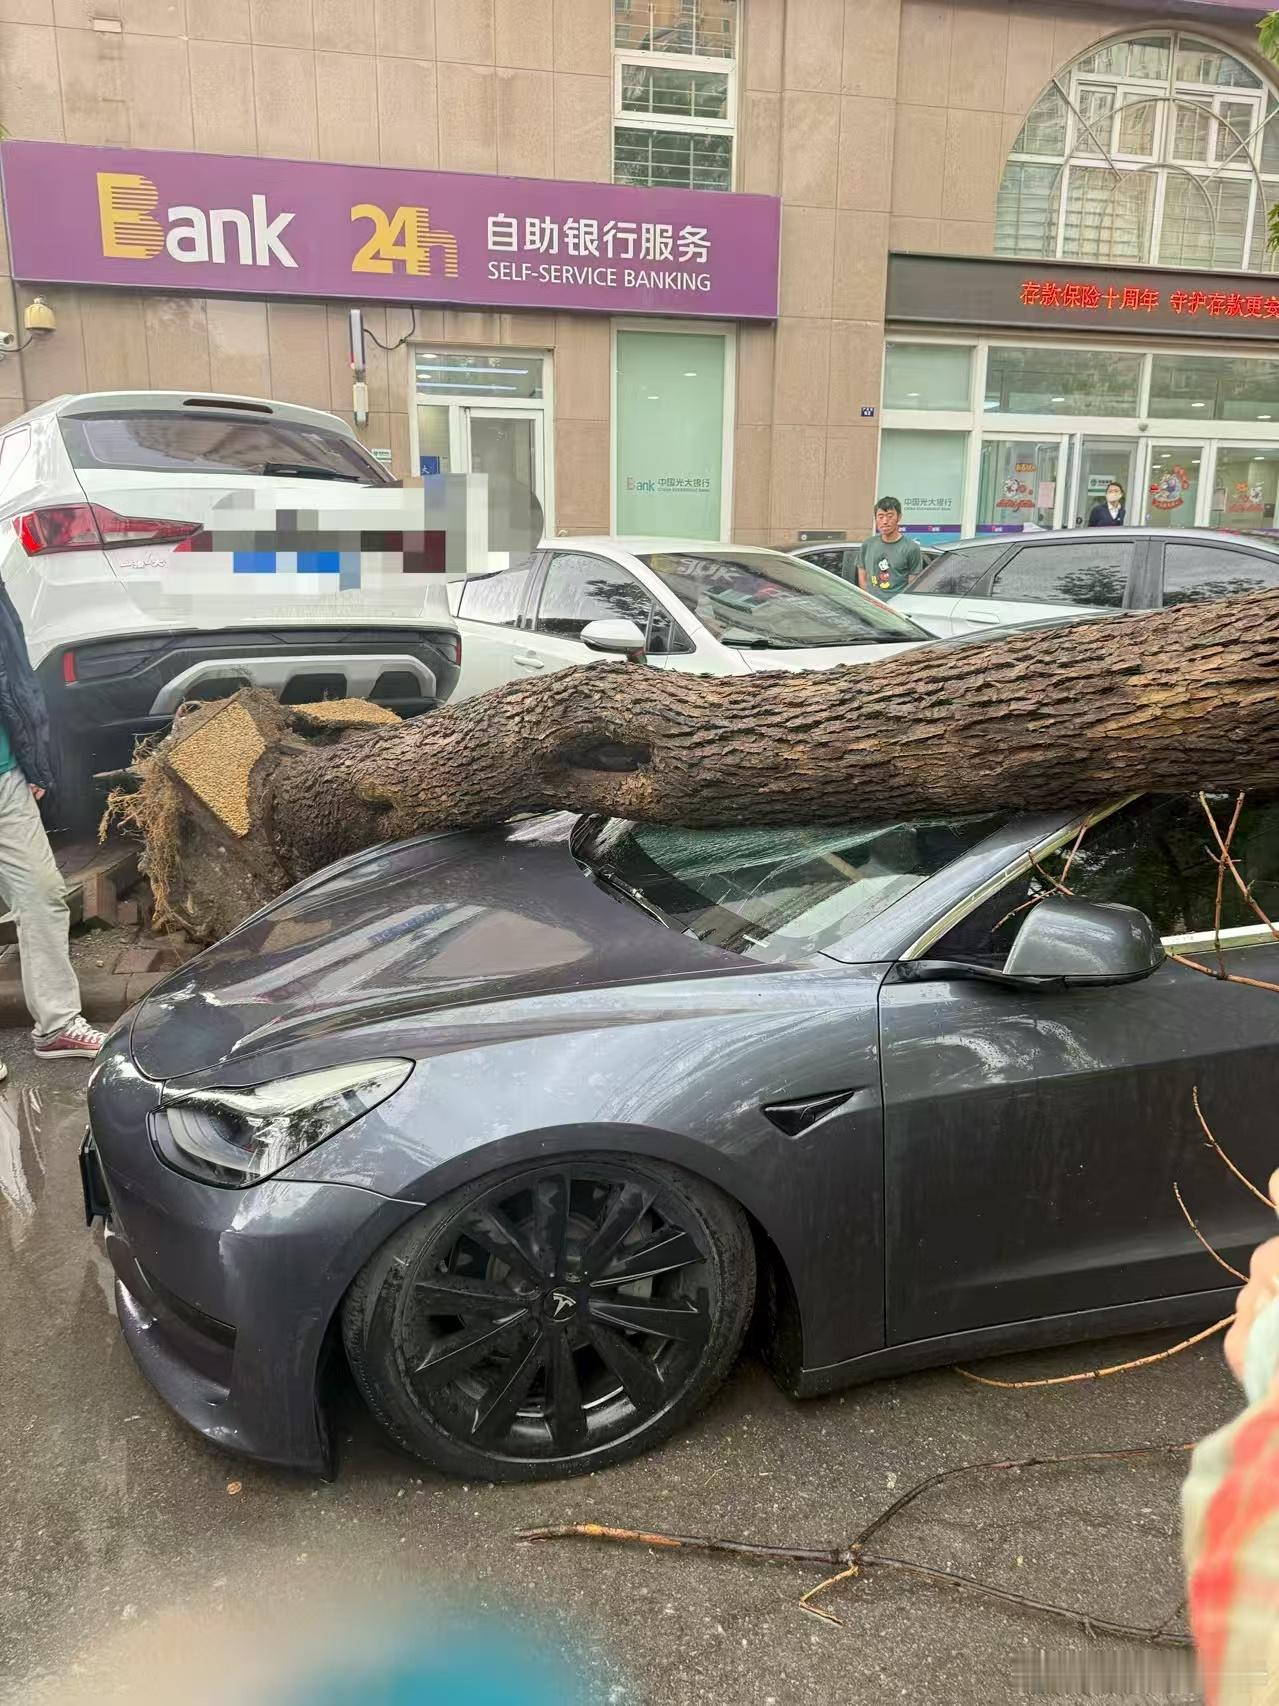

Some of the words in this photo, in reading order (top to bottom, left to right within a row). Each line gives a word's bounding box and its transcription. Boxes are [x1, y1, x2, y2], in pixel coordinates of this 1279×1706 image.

[96, 172, 299, 268] Bank
[350, 203, 459, 278] 24h
[487, 213, 712, 264] 自助银行服务
[487, 261, 617, 287] SELF-SERVICE
[624, 269, 711, 291] BANKING
[1019, 281, 1160, 312] 存款保险十周年
